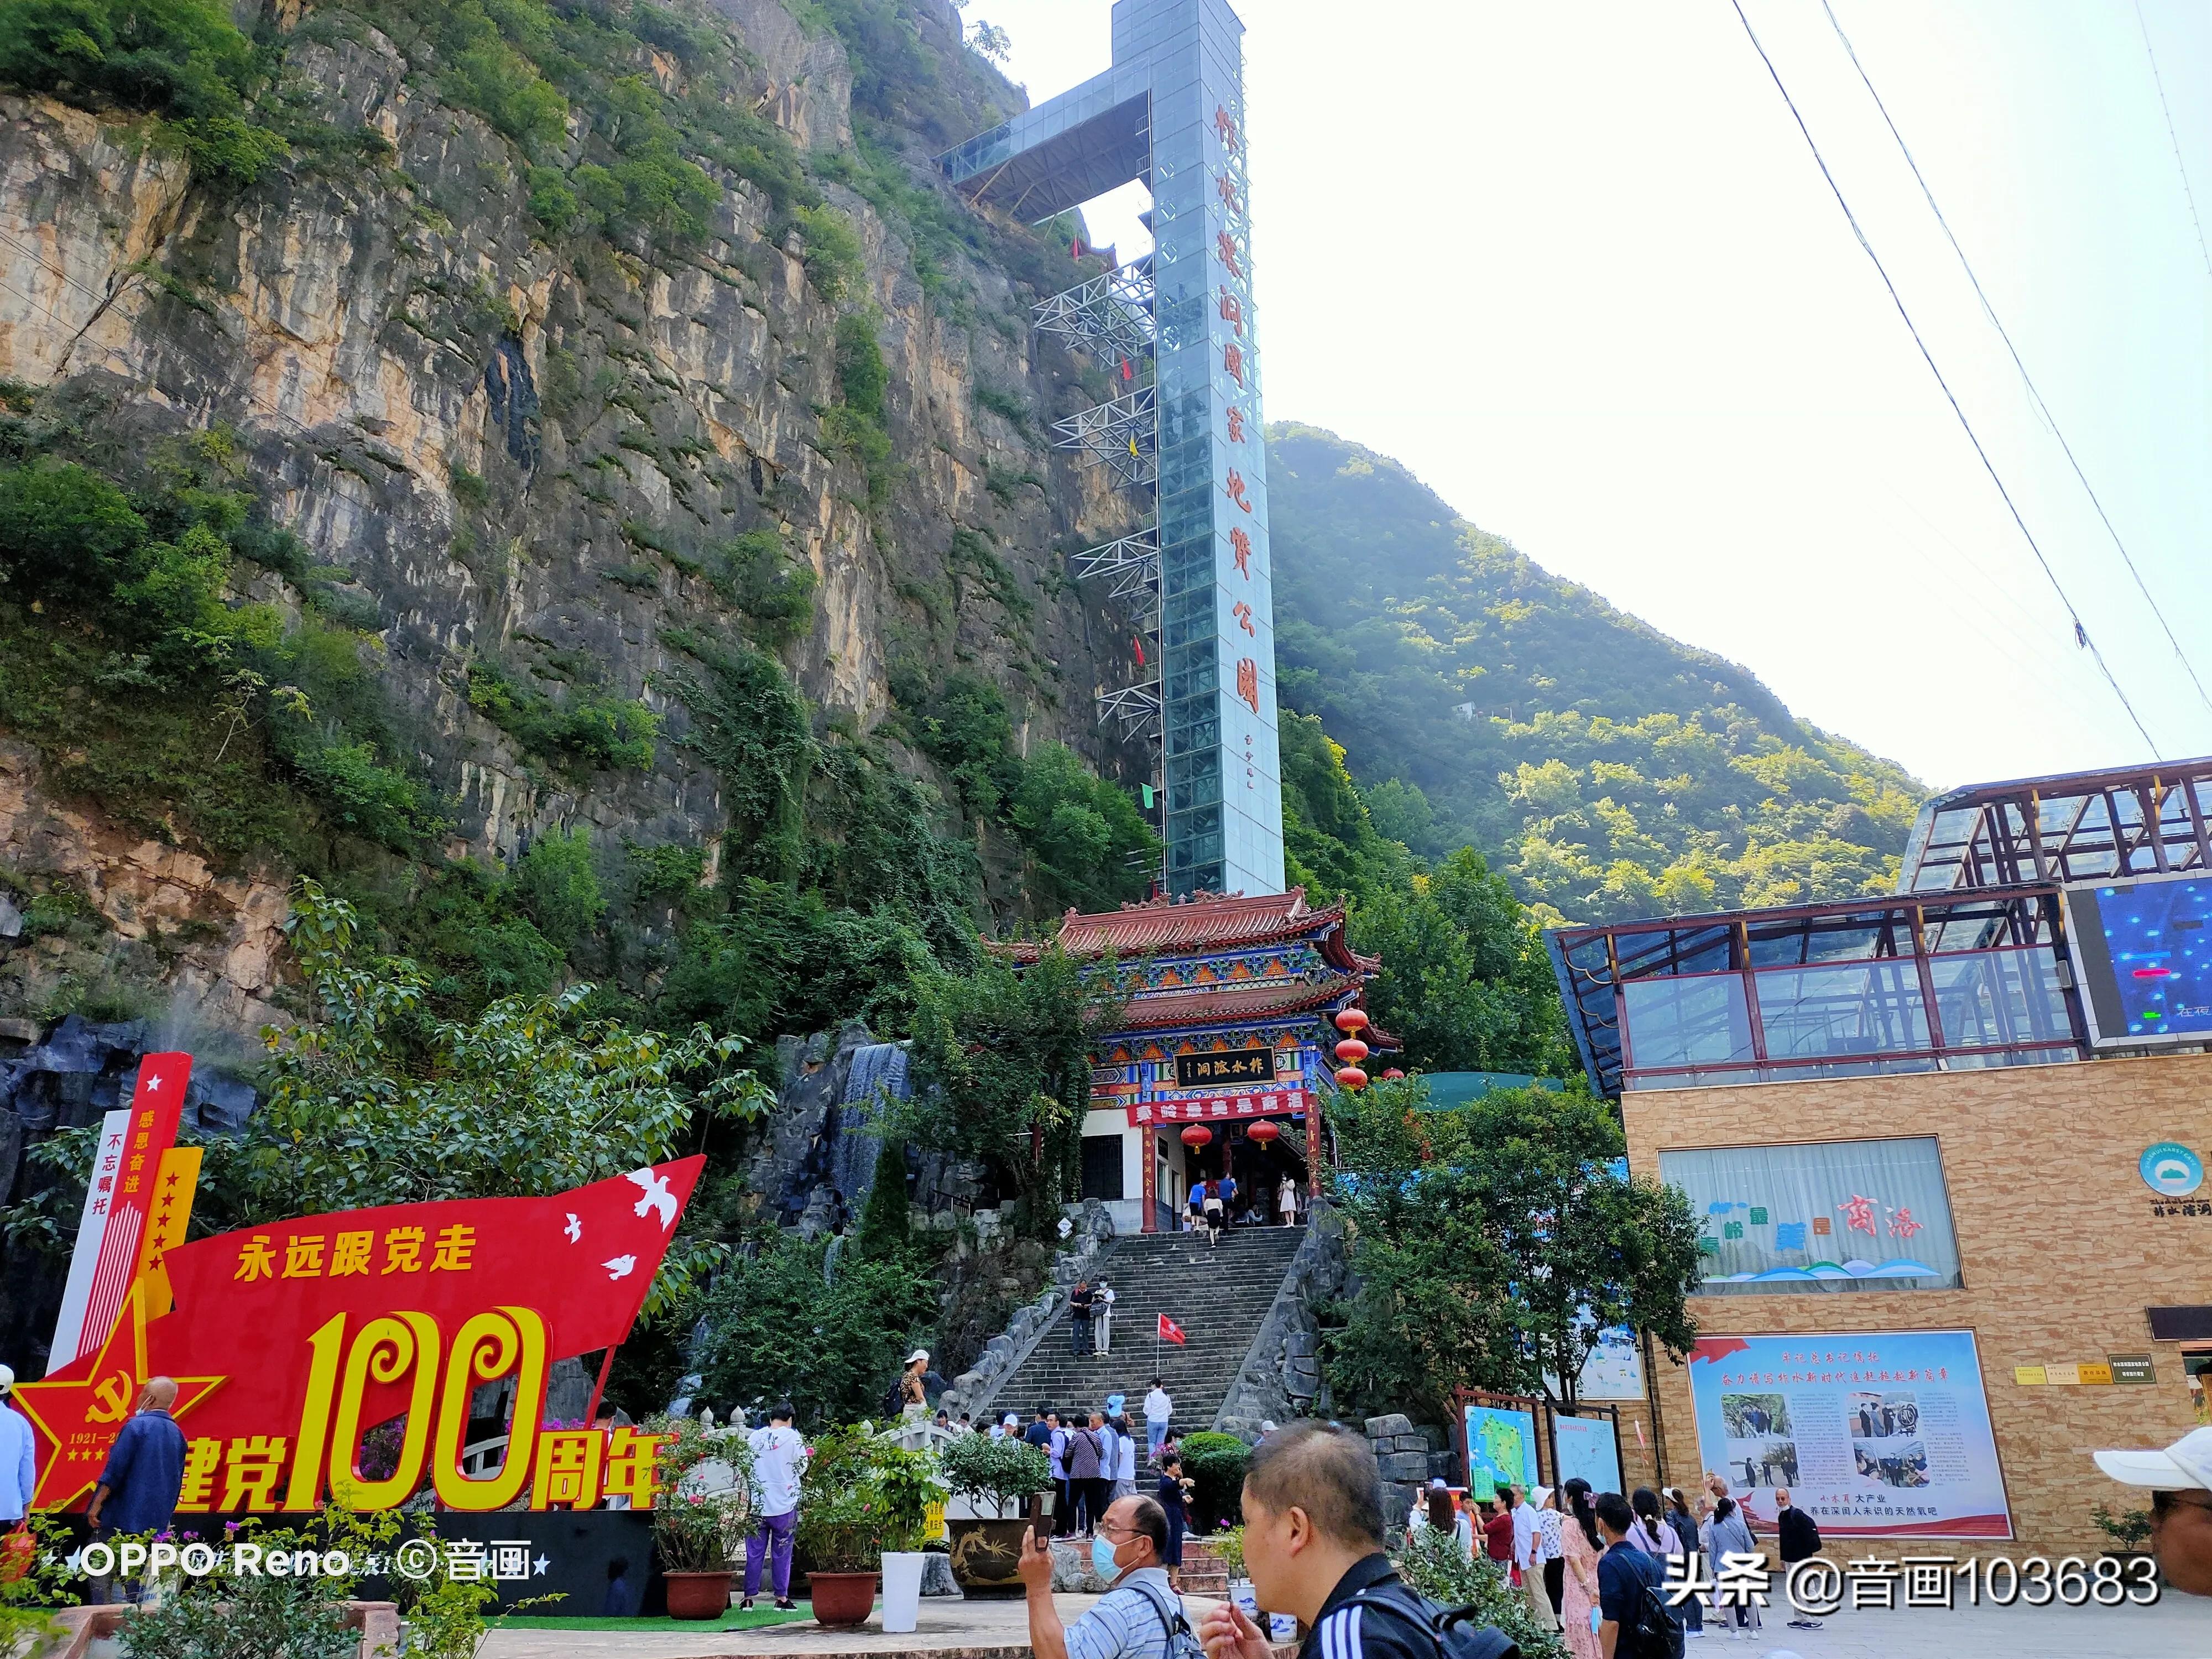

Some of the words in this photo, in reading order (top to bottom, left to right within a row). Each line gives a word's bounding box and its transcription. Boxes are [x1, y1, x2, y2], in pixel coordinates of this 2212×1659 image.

[1197, 1056, 1264, 1077] 柞水溶洞
[1136, 1092, 1304, 1122] 秦岭最美是商洛
[123, 1110, 155, 1194] 感恩奋进
[92, 1133, 123, 1215] 不忘嘱托
[233, 1223, 477, 1282] 永远跟党走
[1781, 1351, 1880, 1364] 牢记总书记嘱托
[1810, 1506, 1938, 1516] 养在深闺人未识的天然氧吧
[1855, 1494, 1887, 1504] 大产业
